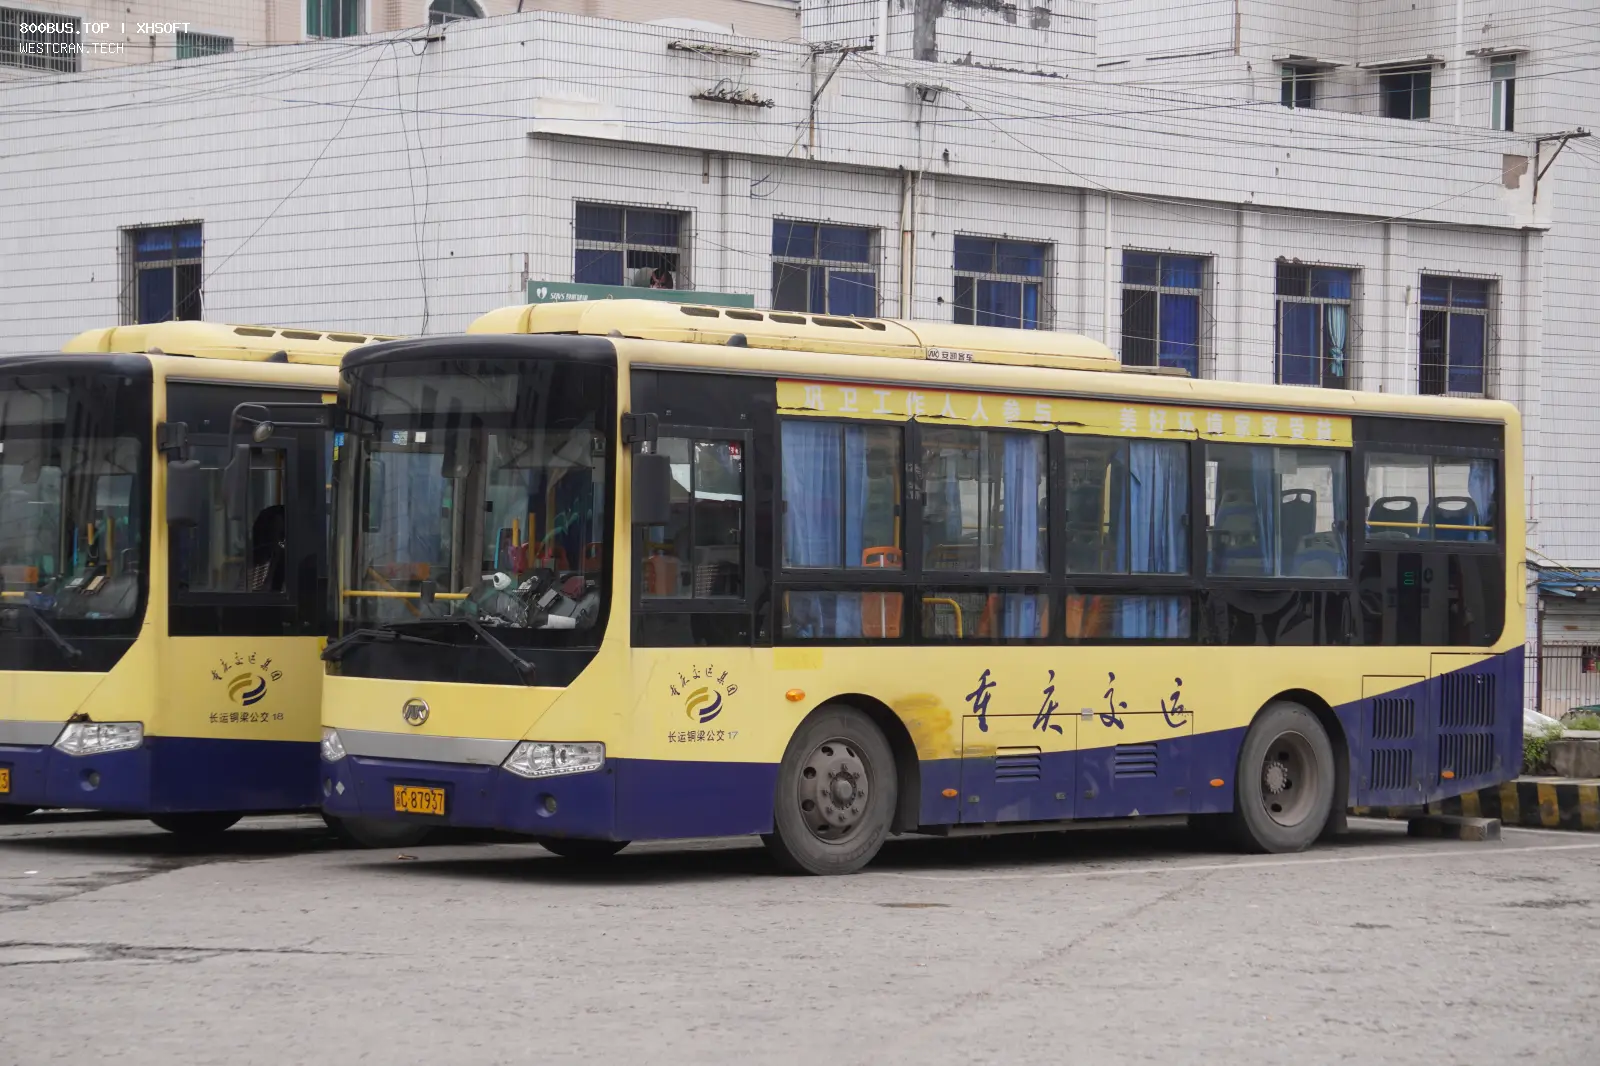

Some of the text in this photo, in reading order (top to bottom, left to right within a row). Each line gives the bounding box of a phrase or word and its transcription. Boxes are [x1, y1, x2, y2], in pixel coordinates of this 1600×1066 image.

[941, 351, 974, 362] 安凯客车
[964, 668, 1189, 736] 重庆交运
[209, 712, 285, 724] 长运铜梁公交 18
[668, 729, 739, 743] 长运铜梁公交 17
